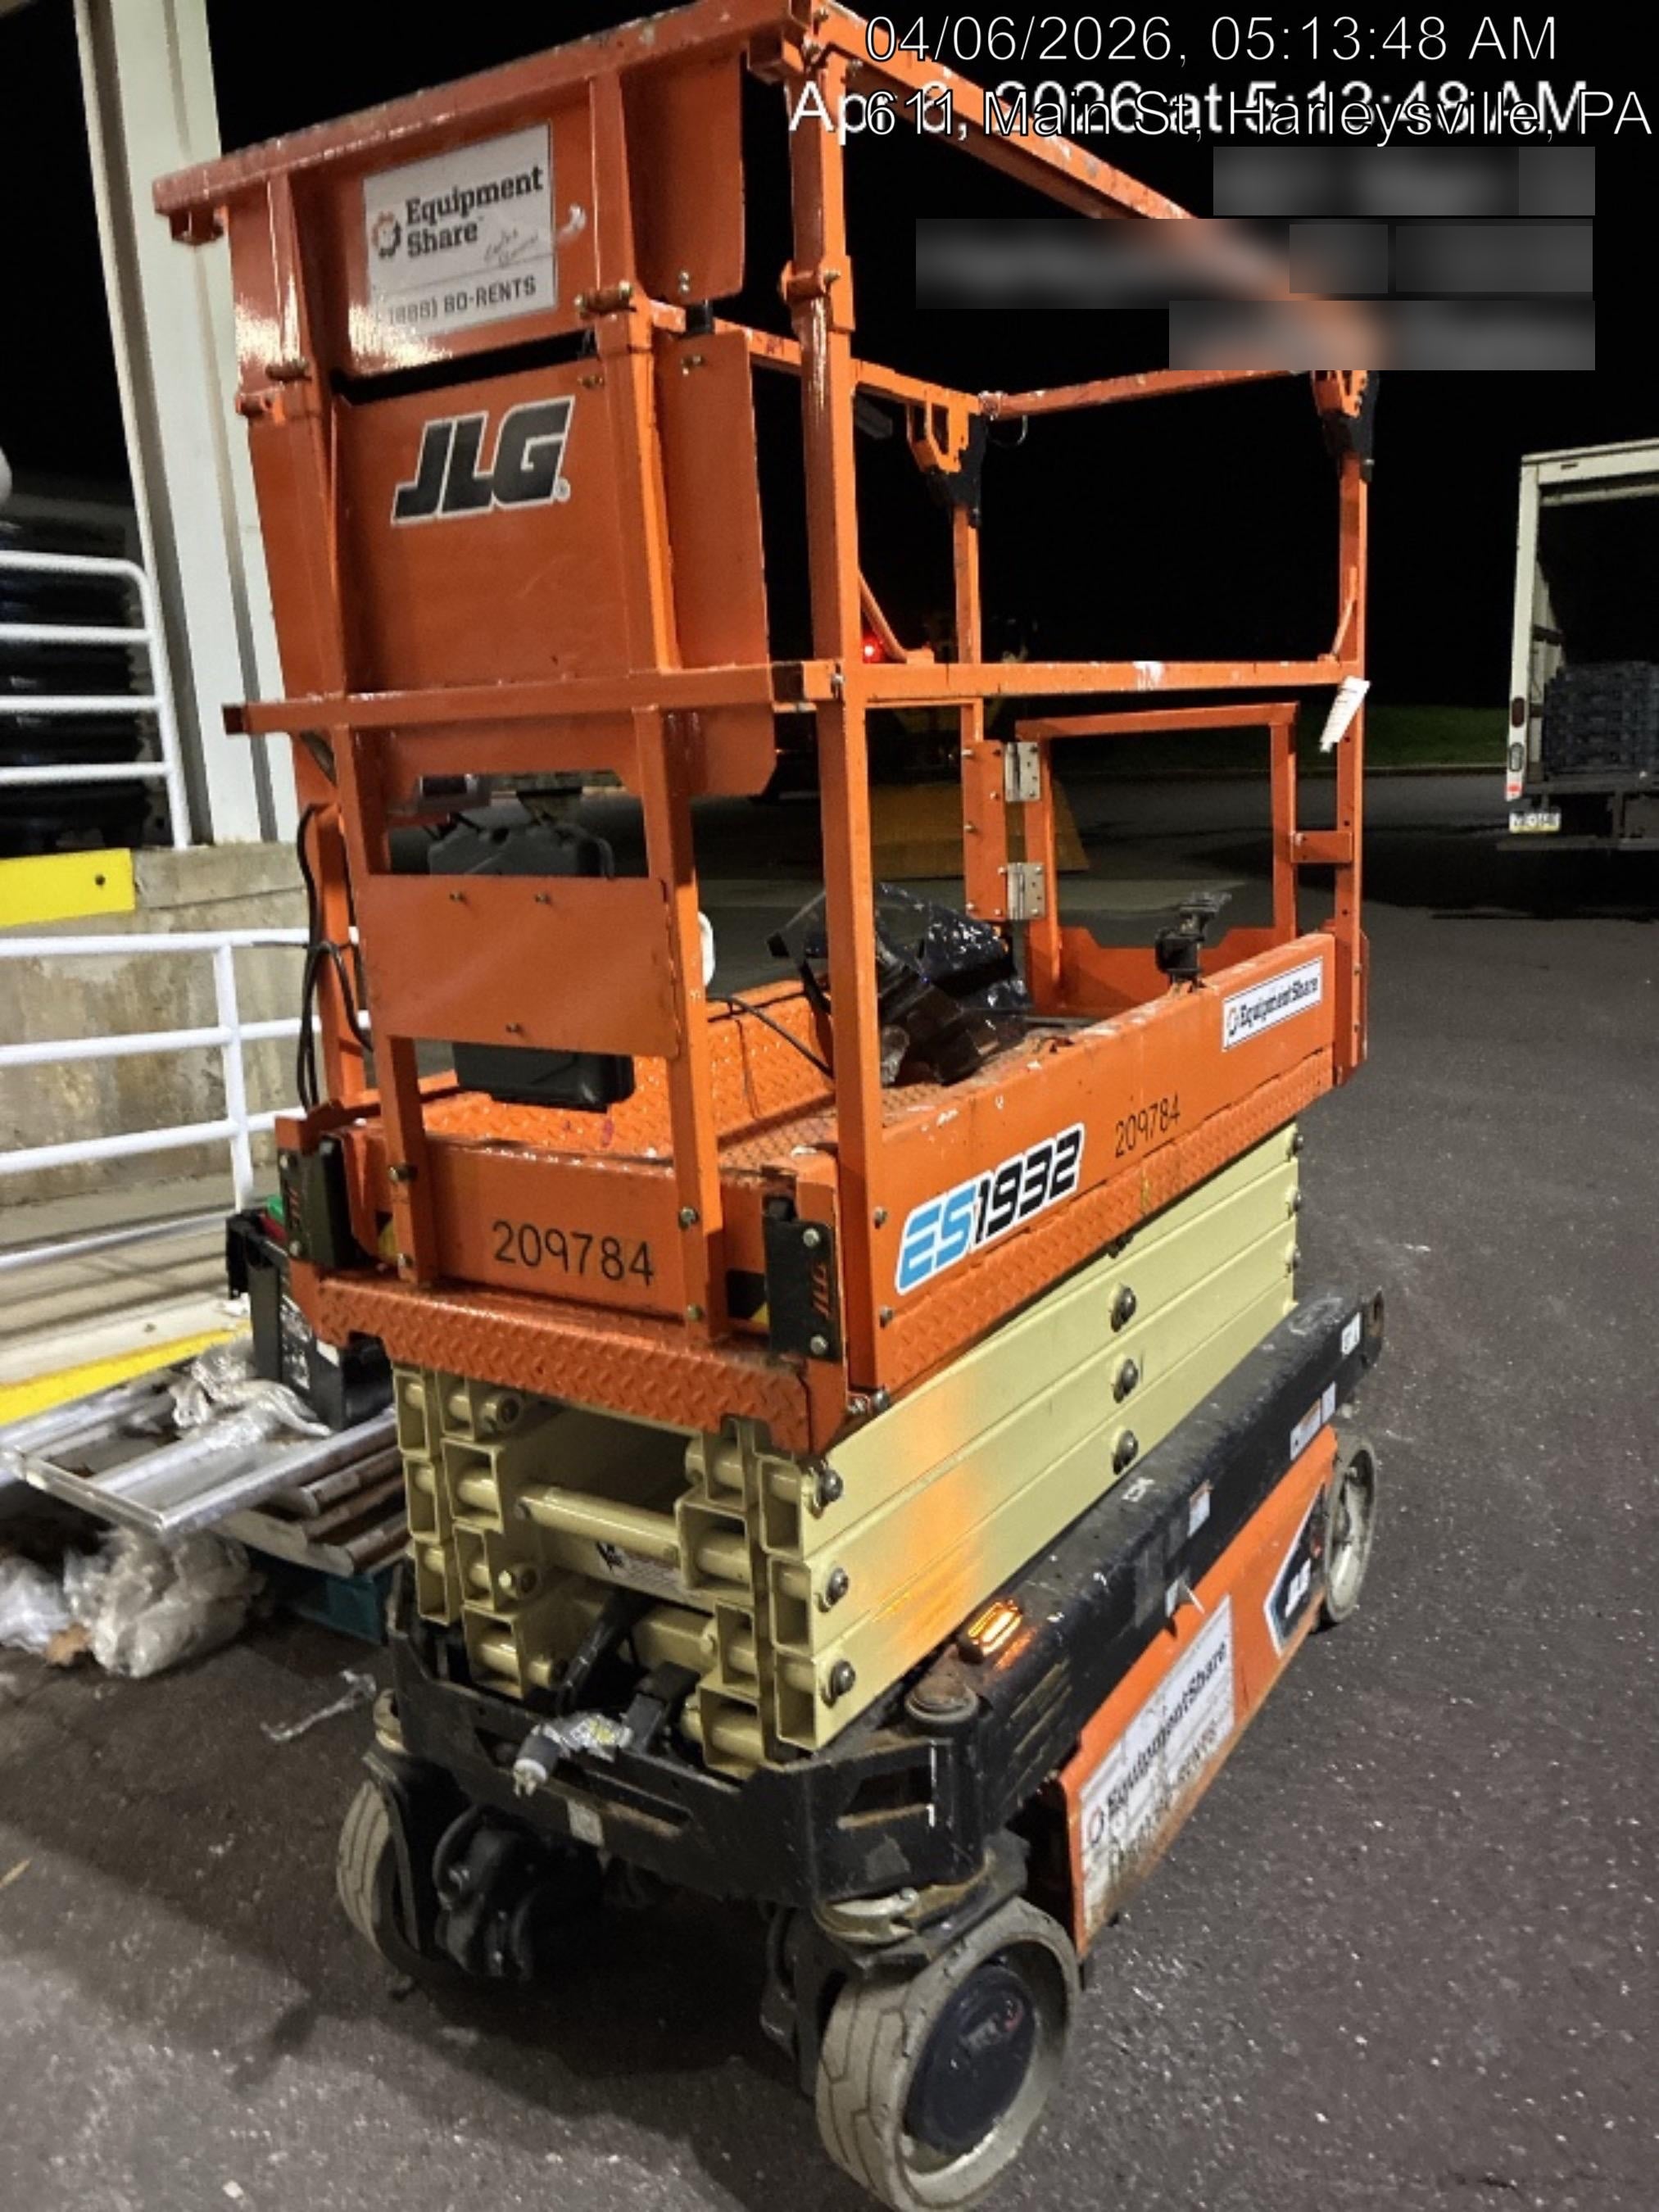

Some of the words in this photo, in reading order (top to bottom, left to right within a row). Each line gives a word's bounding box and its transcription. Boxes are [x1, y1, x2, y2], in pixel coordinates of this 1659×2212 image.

[405, 164, 544, 227] Equipment
[407, 220, 478, 259] Share
[391, 393, 575, 527] JLG
[1114, 1091, 1181, 1158] 209784
[492, 1219, 655, 1287] 209784
